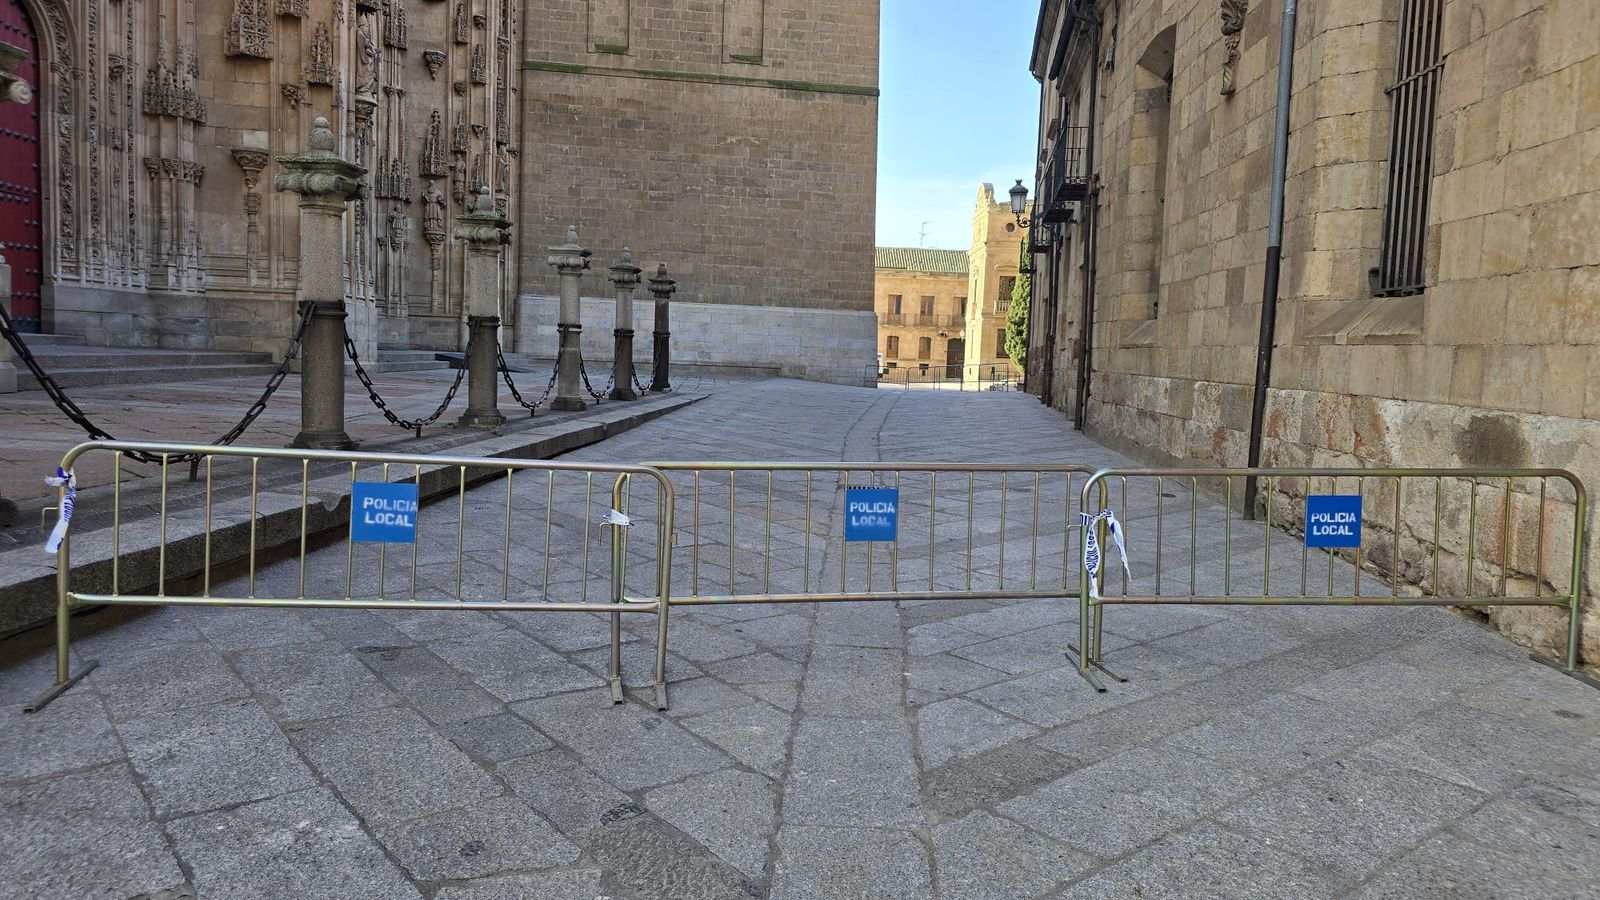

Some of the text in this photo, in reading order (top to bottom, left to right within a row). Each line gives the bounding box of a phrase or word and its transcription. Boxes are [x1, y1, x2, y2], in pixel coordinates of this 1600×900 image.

[363, 496, 417, 512] POLICIA
[850, 502, 895, 513] POLICIA
[365, 511, 414, 527] LOCAL
[852, 515, 891, 526] LOCAL
[1311, 512, 1356, 523] POLICIA
[1313, 525, 1354, 535] LOCAL
